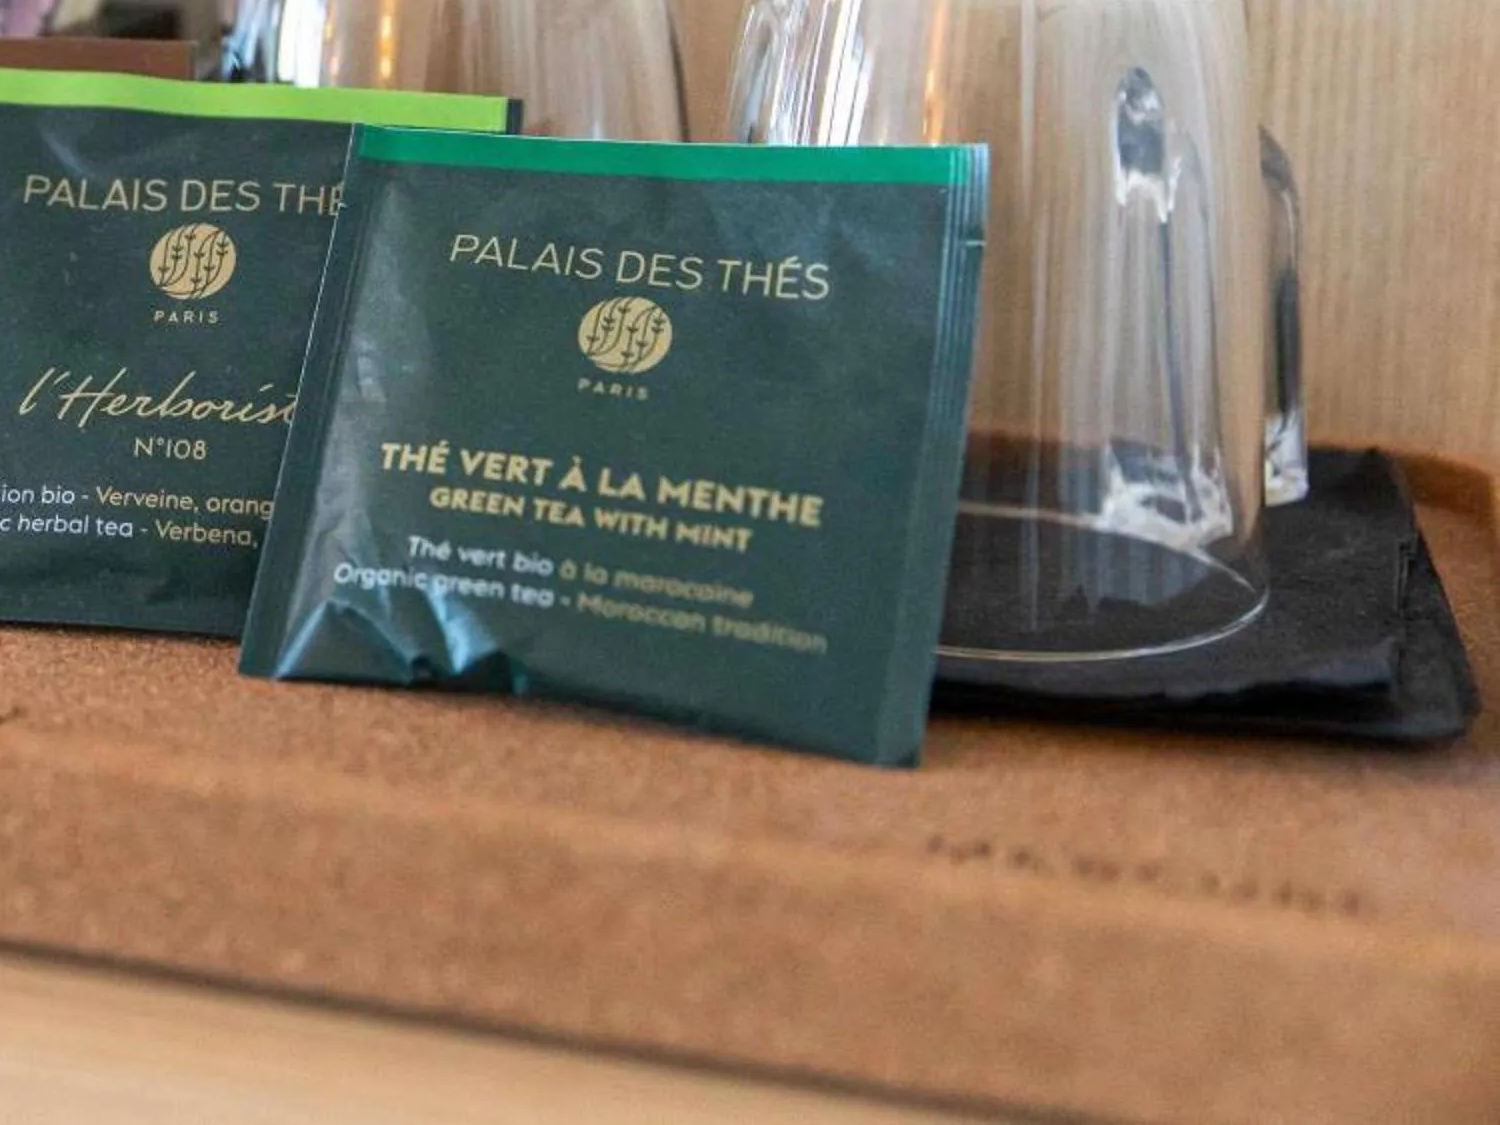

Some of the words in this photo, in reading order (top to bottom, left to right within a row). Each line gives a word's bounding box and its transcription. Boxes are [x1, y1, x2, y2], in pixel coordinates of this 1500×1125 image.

[23, 175, 168, 213] PALAIS
[180, 179, 260, 212] DES
[449, 233, 604, 280] PALAIS
[616, 250, 703, 290] DES
[716, 255, 830, 300] THÉS
[154, 310, 219, 324] PARIS
[577, 378, 649, 401] PARIS
[133, 437, 208, 461] N°108
[42, 485, 75, 505] bio
[96, 486, 199, 513] Verveine,
[381, 440, 450, 475] THÉ
[460, 448, 554, 487] VERT
[558, 456, 588, 493] À
[598, 467, 647, 501] LA
[656, 476, 825, 528] MENTHE
[18, 511, 89, 535] herbal
[97, 517, 134, 537] tea
[155, 520, 258, 548] Verbena,
[430, 486, 525, 518] GREEN
[532, 497, 586, 528] TEA
[593, 507, 668, 541] WITH
[675, 521, 753, 553] MINT
[408, 535, 451, 561] Thé
[458, 547, 507, 570] vert
[513, 551, 554, 577] bio
[334, 562, 428, 591] Organic
[511, 582, 555, 608] tea
